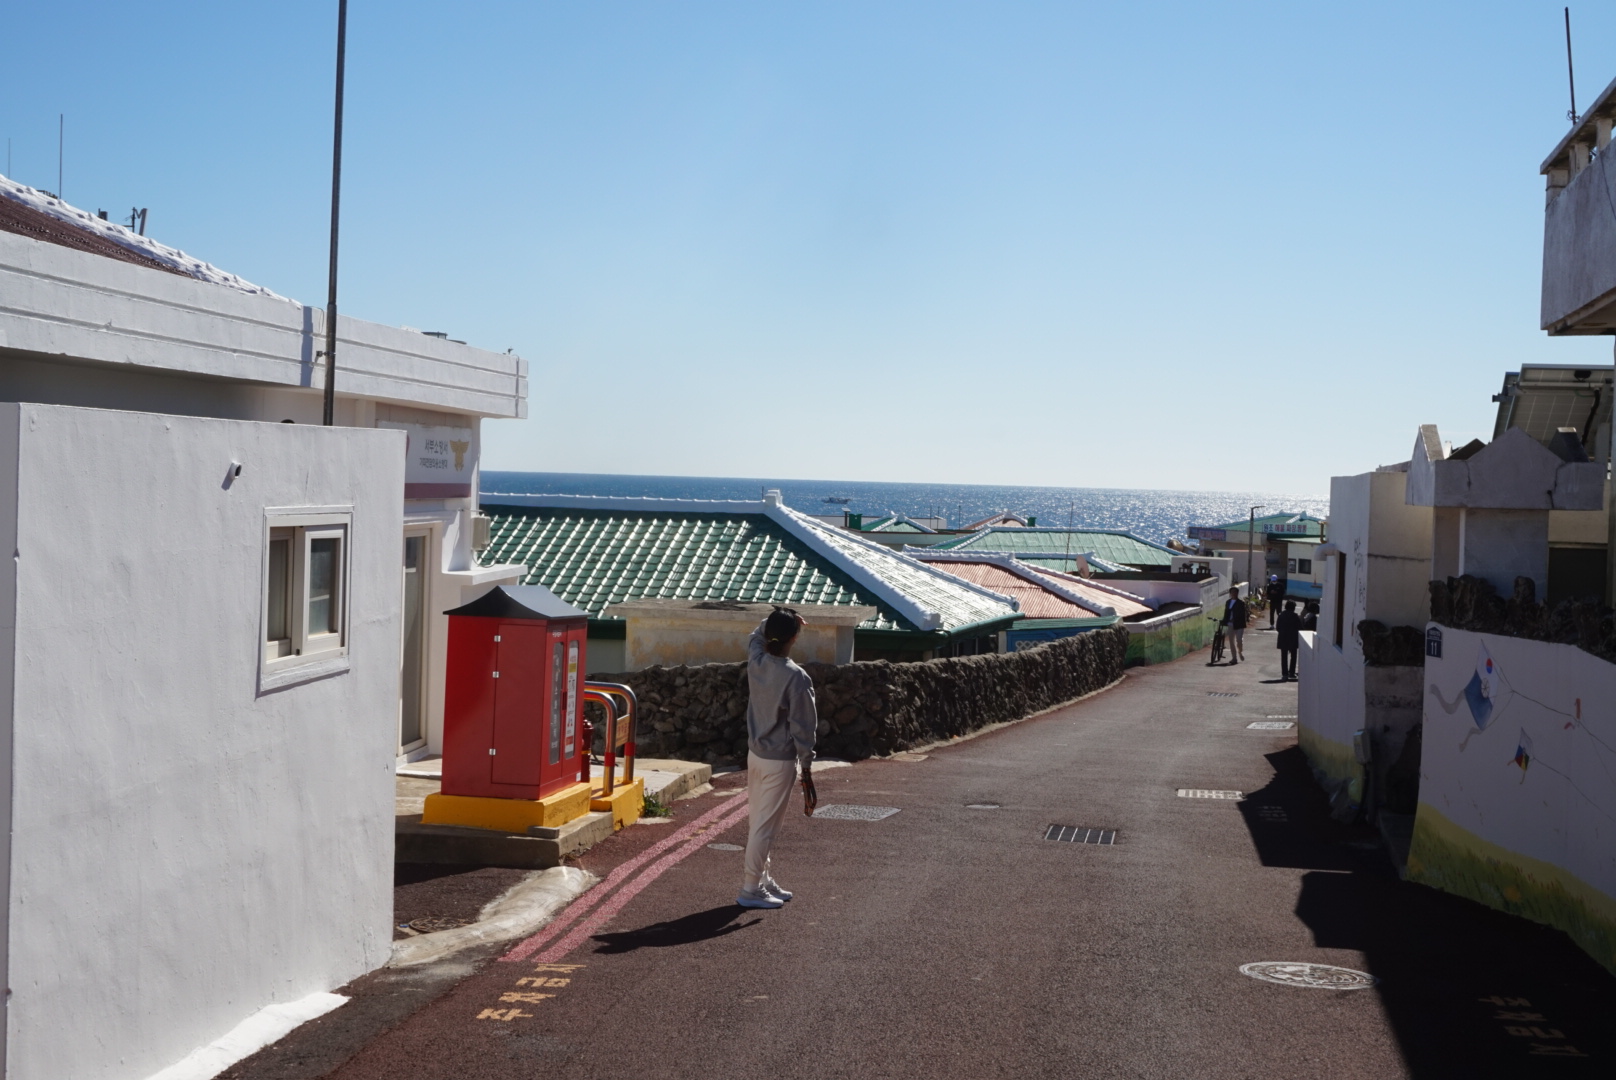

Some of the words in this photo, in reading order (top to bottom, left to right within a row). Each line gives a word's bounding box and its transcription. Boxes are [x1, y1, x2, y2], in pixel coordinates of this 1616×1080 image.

[425, 439, 448, 455] 서부소방서
[1264, 524, 1274, 532] 원조
[1430, 641, 1438, 656] 11
